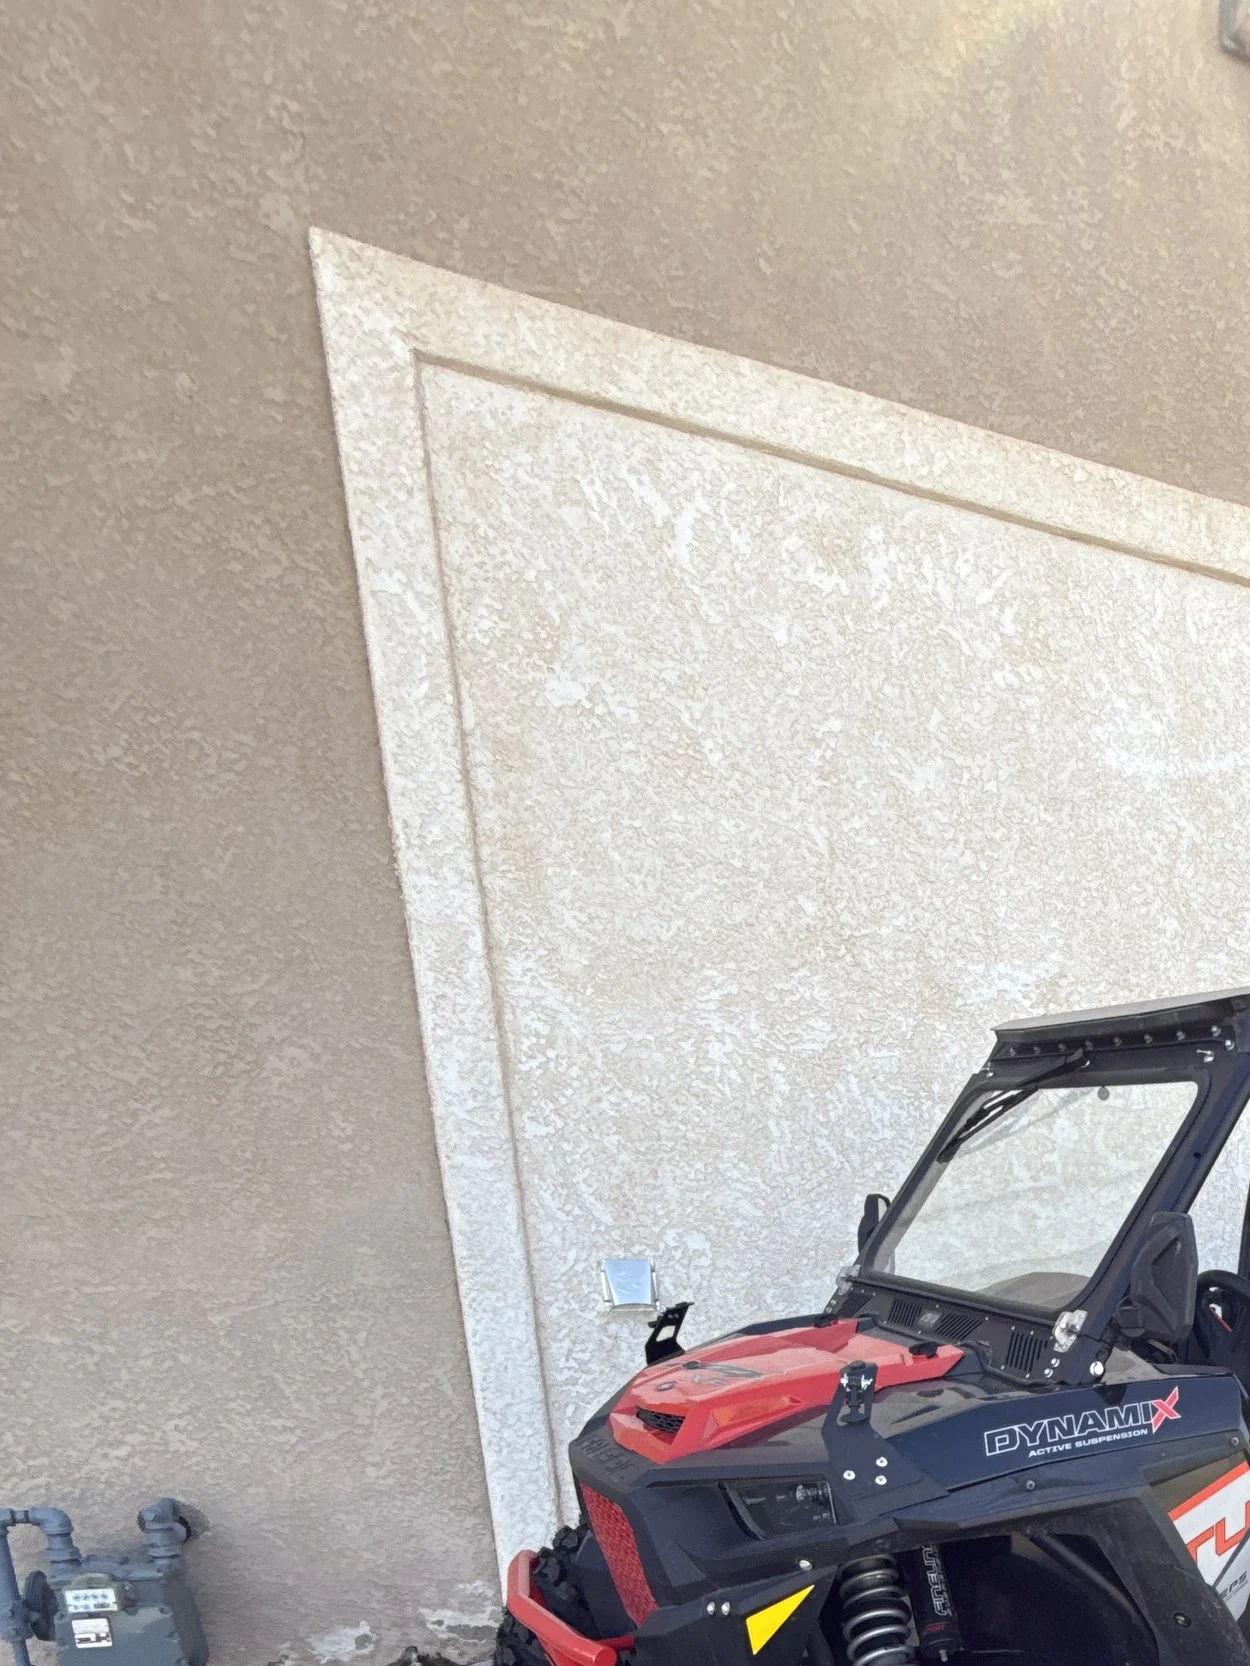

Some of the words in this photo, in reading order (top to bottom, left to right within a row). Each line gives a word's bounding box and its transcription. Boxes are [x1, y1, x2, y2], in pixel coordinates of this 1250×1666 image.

[984, 1386, 1181, 1456] DYNAMIX
[1028, 1442, 1072, 1458] ACTIVE
[1075, 1428, 1149, 1448] SUSPENSION
